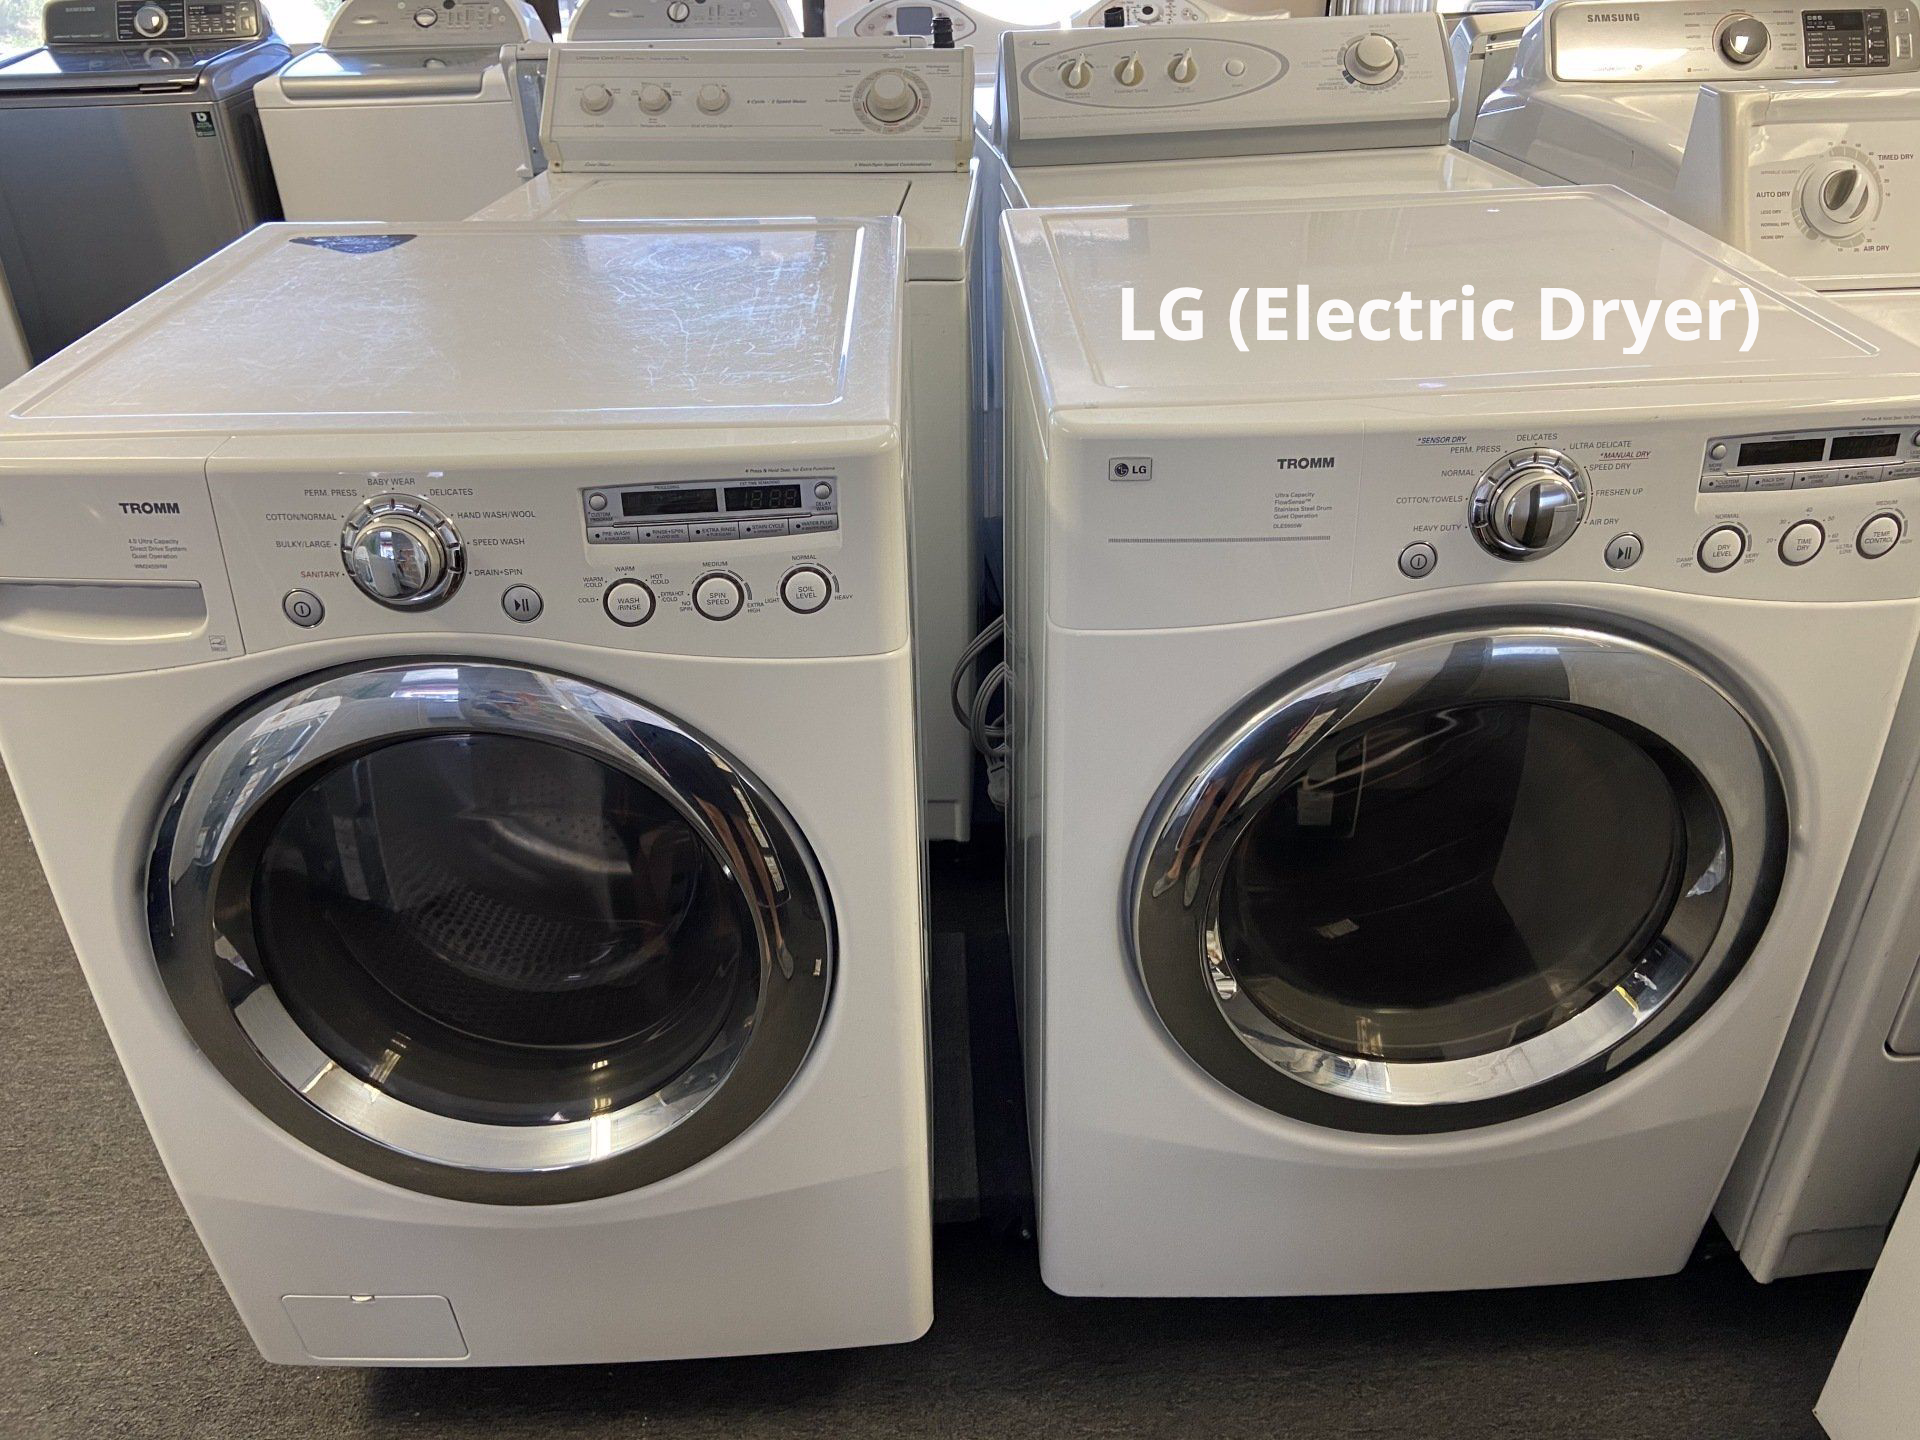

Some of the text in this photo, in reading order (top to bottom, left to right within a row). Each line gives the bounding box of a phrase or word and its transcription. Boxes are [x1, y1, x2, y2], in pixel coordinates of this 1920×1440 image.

[1587, 13, 1640, 22] SAMSUNG
[1277, 457, 1335, 469] TROMM
[1132, 466, 1147, 474] LG
[118, 502, 180, 514] TROMM
